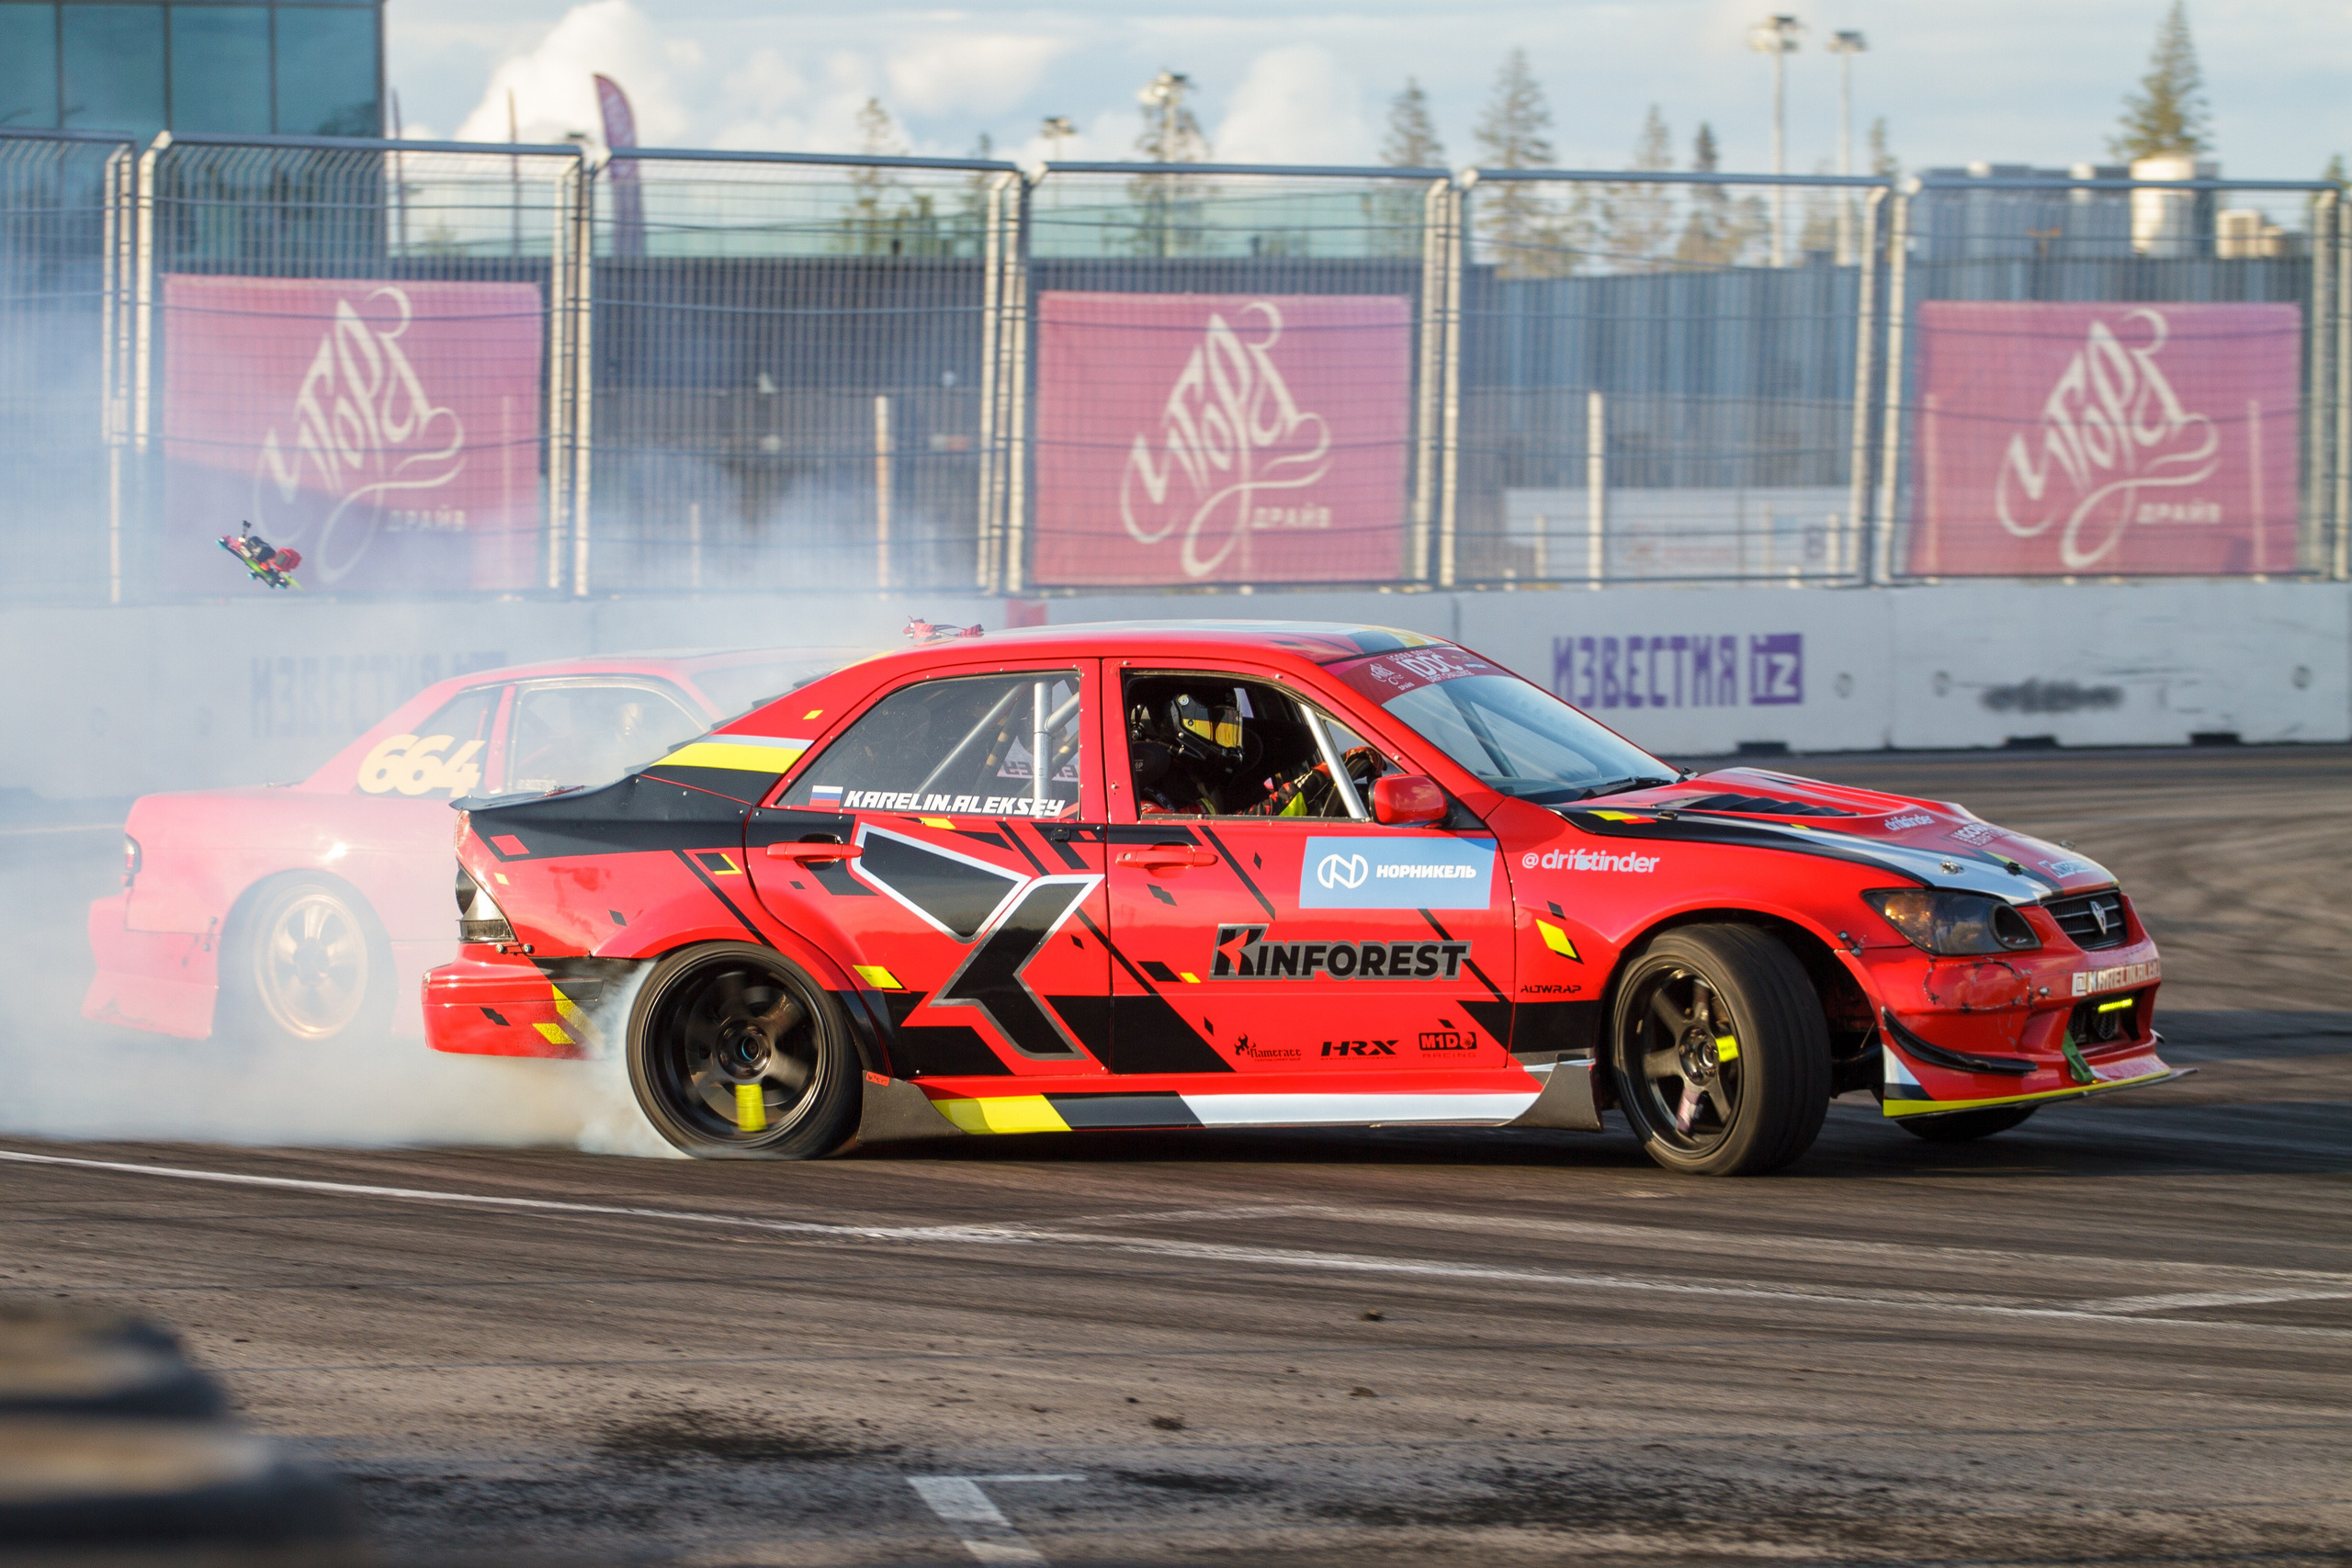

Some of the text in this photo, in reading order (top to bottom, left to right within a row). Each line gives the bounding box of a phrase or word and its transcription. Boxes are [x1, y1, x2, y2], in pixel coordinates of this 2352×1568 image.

[1553, 635, 1736, 708] ИЗВЕСТИЯ
[357, 734, 486, 797] 664
[843, 790, 1066, 816] KARELIN.ALEKSEY
[1376, 864, 1476, 879] НОРНИКЕЛЬ
[1211, 926, 1469, 978] KINFOREST
[1321, 1040, 1399, 1056] HRX
